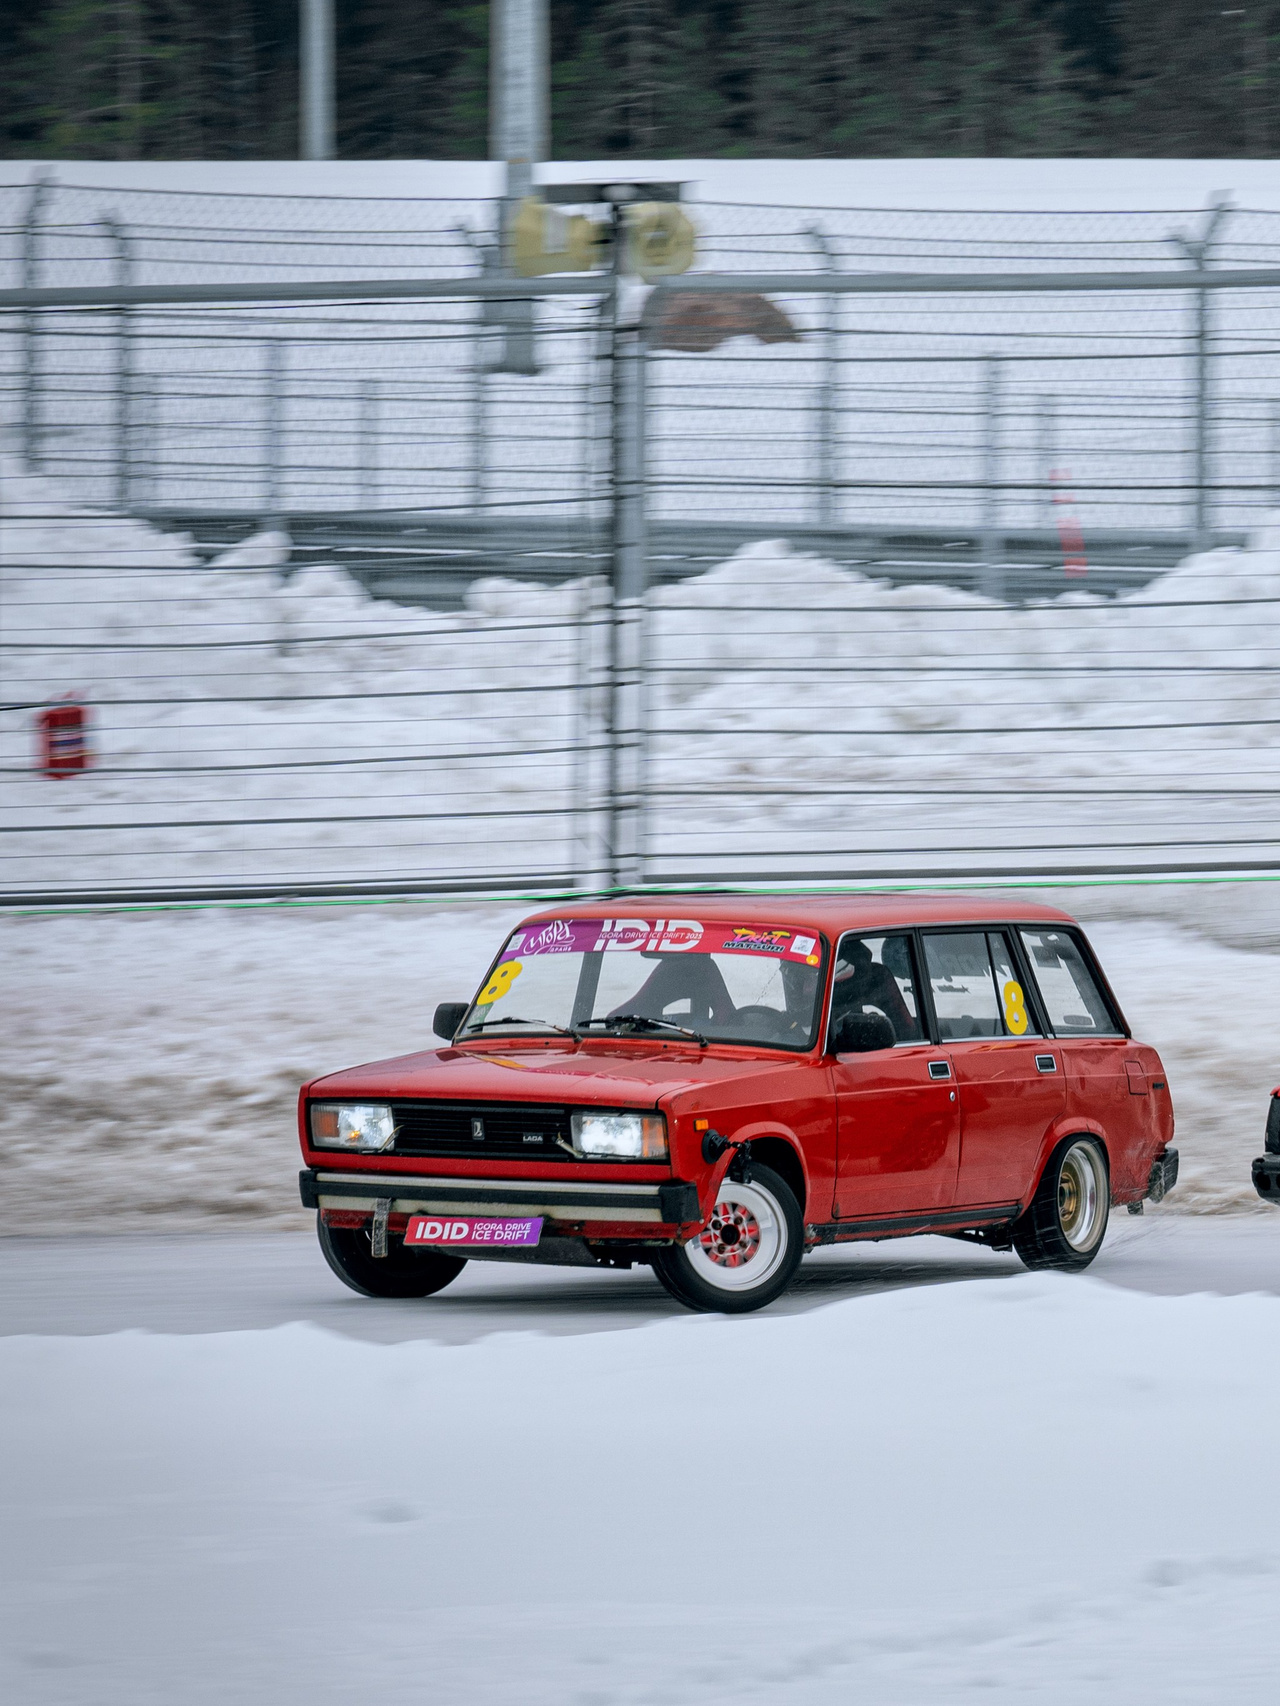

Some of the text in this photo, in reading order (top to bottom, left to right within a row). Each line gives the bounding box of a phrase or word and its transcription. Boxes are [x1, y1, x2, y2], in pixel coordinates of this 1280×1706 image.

[593, 919, 704, 951] IDID
[722, 941, 785, 953] MATSURI
[476, 961, 523, 1006] 8
[1004, 980, 1028, 1035] 8
[415, 1222, 469, 1240] IDID
[471, 1230, 530, 1240] ICE DRIFT
[473, 1222, 532, 1231] IGORA DRIVE
